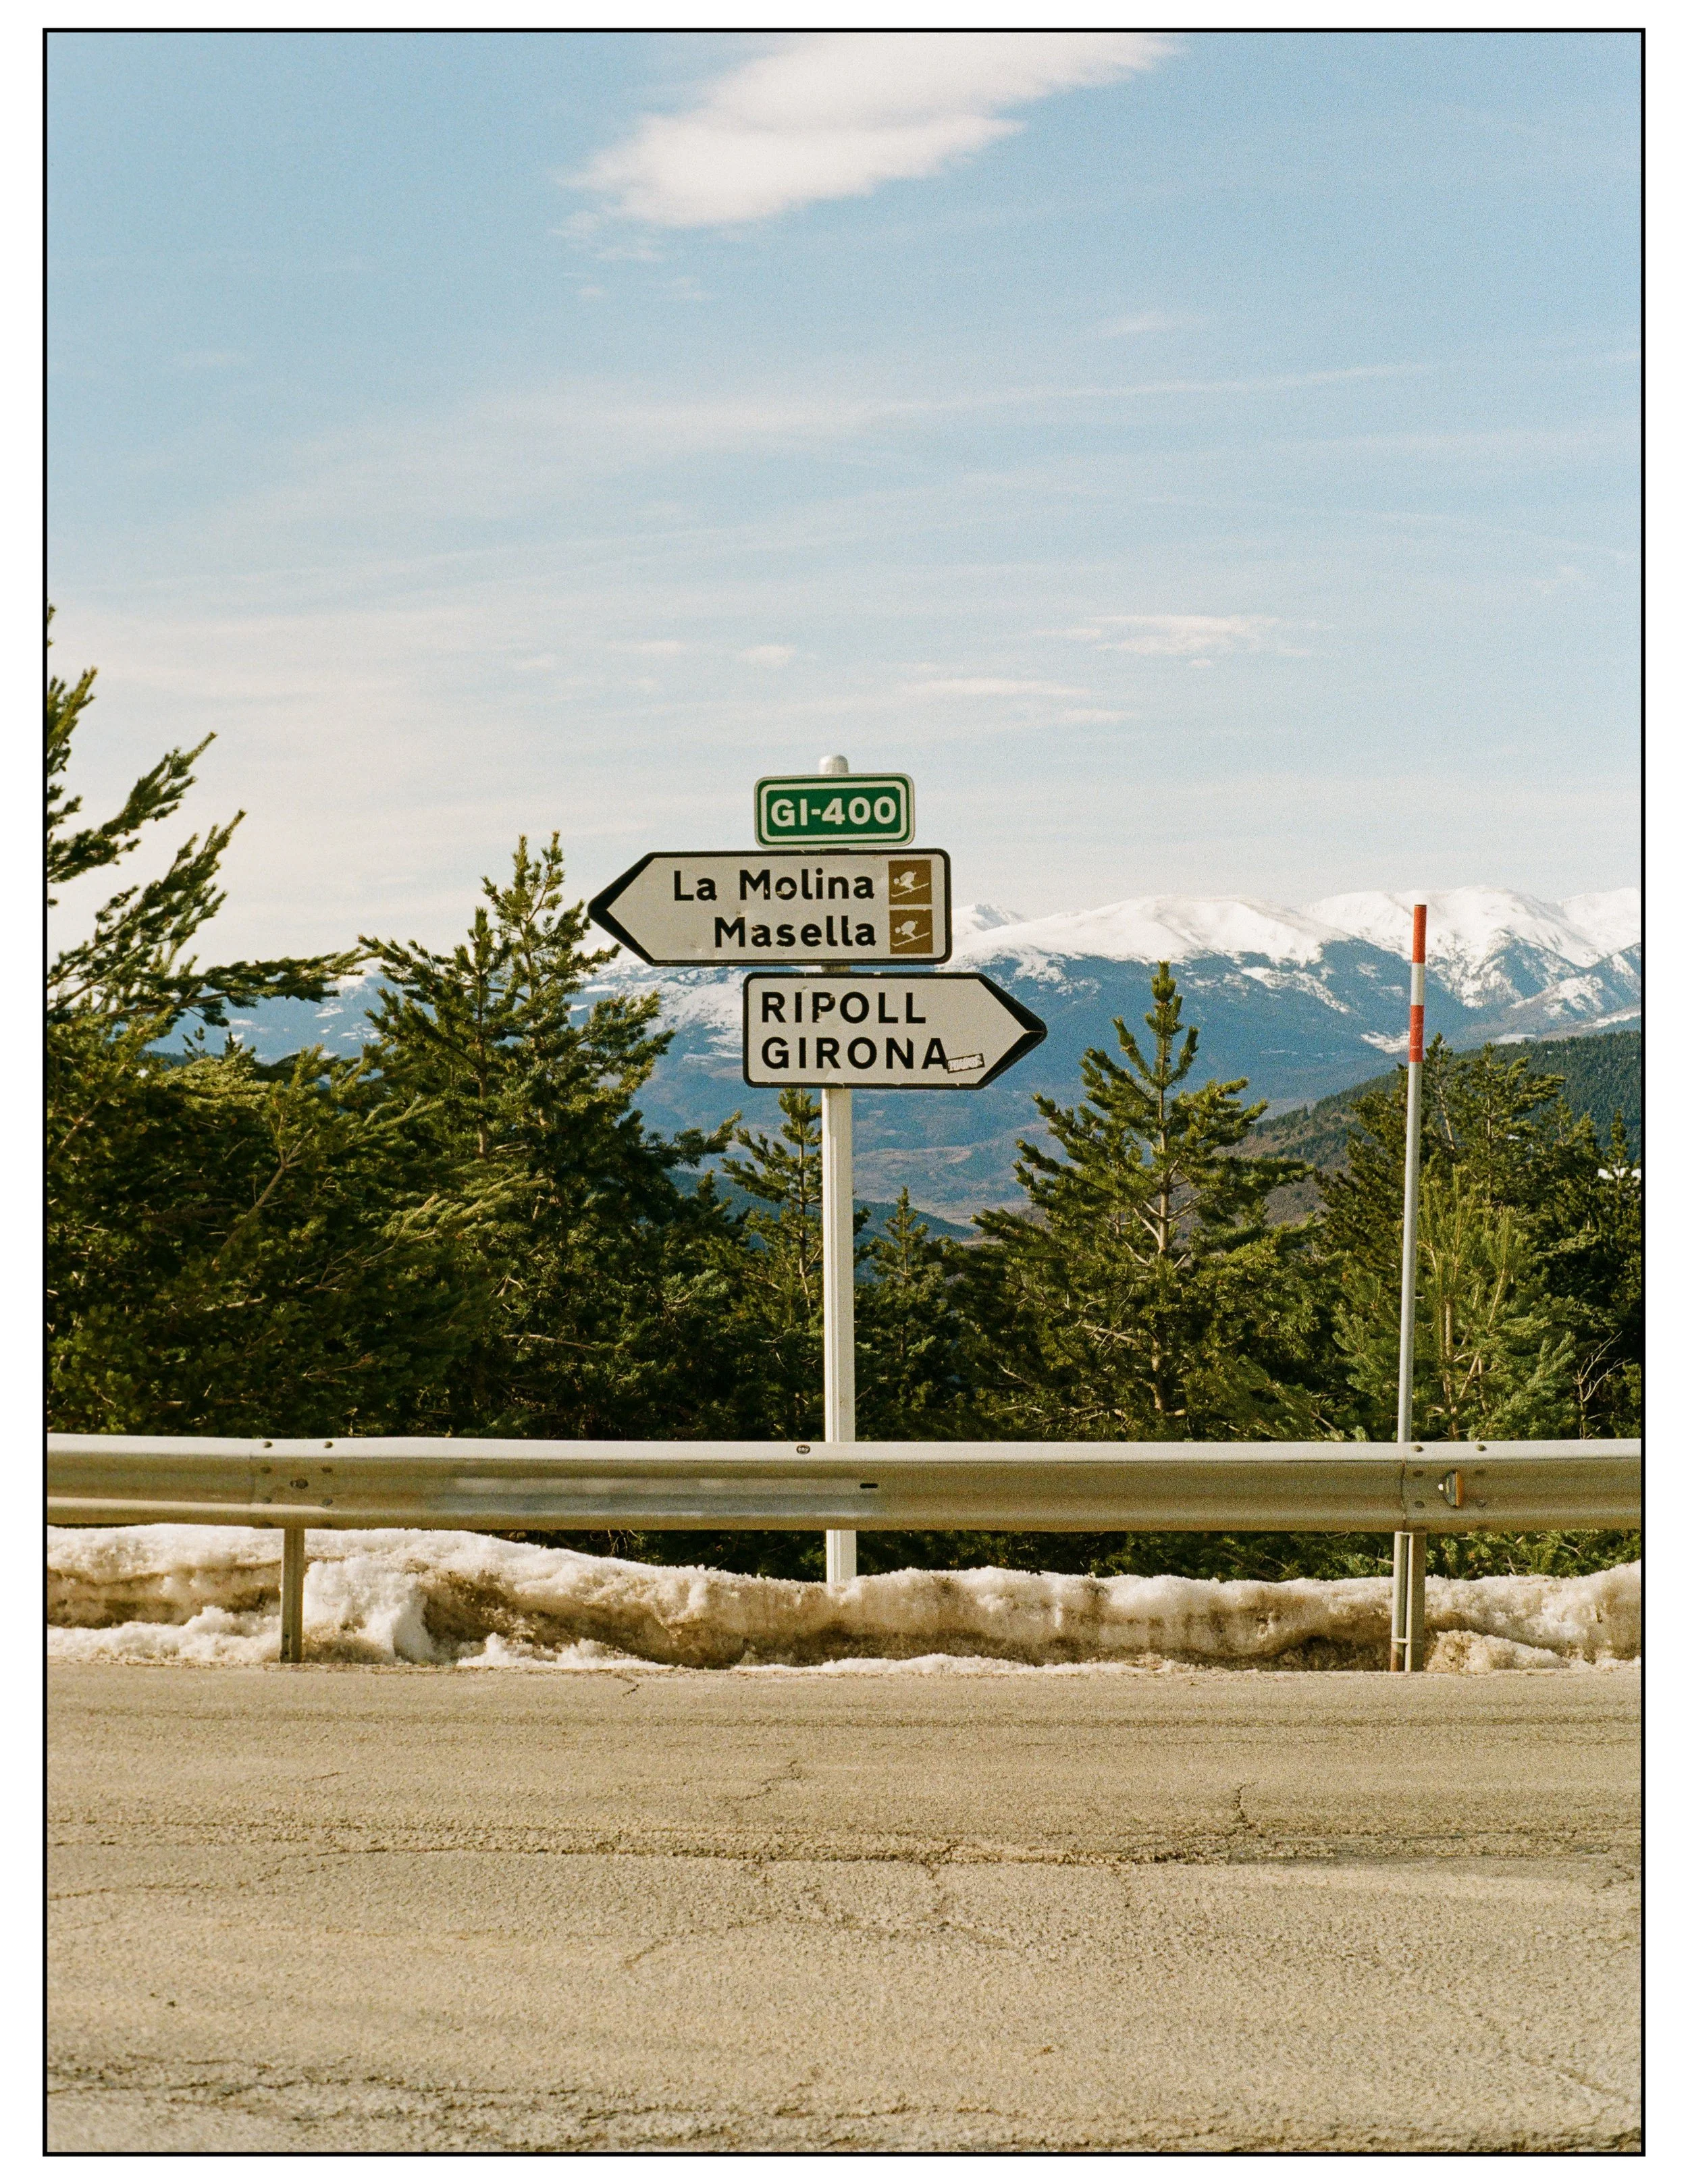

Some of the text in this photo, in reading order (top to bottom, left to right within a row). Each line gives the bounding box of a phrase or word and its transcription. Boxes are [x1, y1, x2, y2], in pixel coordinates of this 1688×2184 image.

[771, 796, 897, 827] GI-400
[674, 867, 875, 901] La Molina
[714, 915, 876, 948] Masella
[762, 991, 926, 1024] RIPOLL
[761, 1036, 947, 1070] GIRONA
